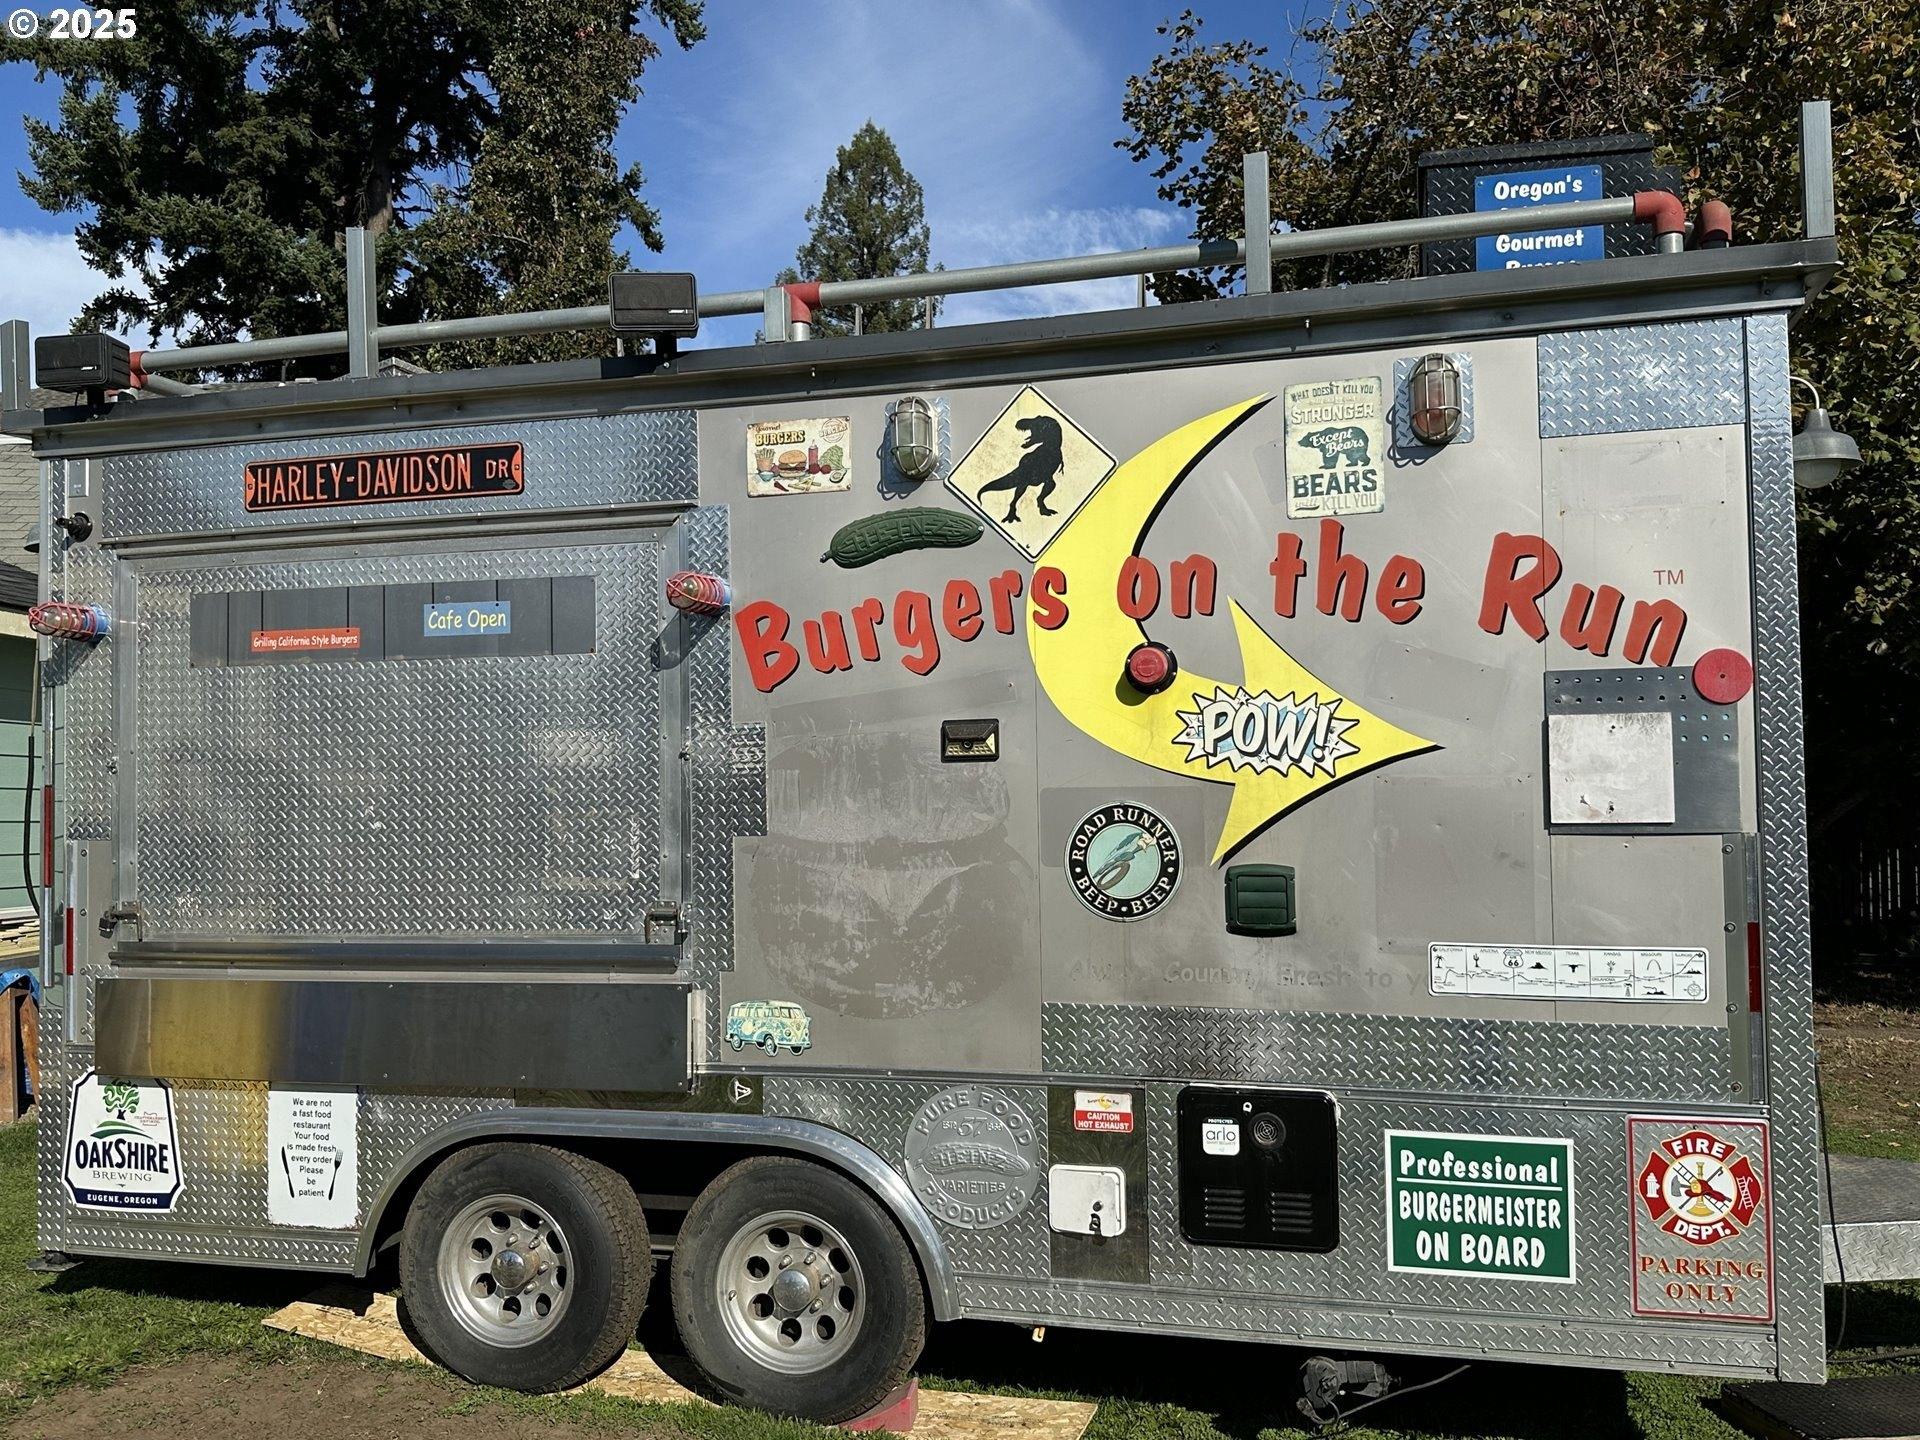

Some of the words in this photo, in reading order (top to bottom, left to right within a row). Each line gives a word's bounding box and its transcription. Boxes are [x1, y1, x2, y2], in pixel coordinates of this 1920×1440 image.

[1494, 175, 1583, 201] Oregon's
[1496, 229, 1584, 253] Gourmet
[1291, 391, 1309, 402] WHAT
[1343, 385, 1359, 394] KILL
[1360, 384, 1374, 394] YOU
[1291, 403, 1374, 425] STRONGER
[755, 430, 805, 446] BURGERS
[1310, 428, 1353, 446] Except
[1326, 439, 1365, 457] Bears
[257, 453, 471, 504] HARLEY-DAVIDSON
[486, 459, 509, 480] DR
[1292, 469, 1377, 498] BEARS
[1322, 495, 1352, 511] KILL
[1354, 492, 1377, 508] YOU
[734, 566, 1069, 693] Burgers
[1117, 554, 1217, 620] on
[1269, 518, 1425, 624] the
[1478, 531, 1687, 667] Run
[1653, 569, 1684, 585] TM
[428, 609, 463, 630] Cafe
[467, 609, 507, 633] Open
[253, 634, 277, 650] Grilling
[278, 635, 310, 648] California
[311, 634, 330, 648] Style
[331, 634, 358, 647] Burgers
[1202, 700, 1333, 763] POW!
[1072, 813, 1107, 861] ROAD
[1113, 807, 1177, 862] RUNNER
[1076, 875, 1118, 913] BEEP
[1130, 876, 1172, 914] BEEP
[292, 1098, 304, 1106] We
[306, 1099, 318, 1107] are
[320, 1099, 332, 1107] not
[299, 1109, 314, 1117] fast
[315, 1110, 332, 1118] food
[915, 1090, 970, 1136] PURE
[978, 1091, 1032, 1146] FOOD
[1087, 1112, 1120, 1121] CAUTION
[293, 1121, 331, 1130] restaurant
[957, 1116, 988, 1138] 57
[1094, 1121, 1130, 1130] EXHAUST
[1206, 1126, 1236, 1141] arlo
[294, 1131, 311, 1140] Your
[313, 1132, 330, 1141] food
[75, 1138, 169, 1174] OAKSHIRE
[295, 1143, 316, 1151] made
[318, 1144, 337, 1153] fresh
[1671, 1138, 1727, 1159] FIRE
[291, 1155, 311, 1164] every
[313, 1155, 332, 1164] order
[938, 1149, 1007, 1170] HEINZ
[1399, 1149, 1558, 1184] Professional
[92, 1170, 152, 1182] BREWING
[299, 1165, 324, 1174] Please
[306, 1177, 316, 1185] be
[941, 1178, 1006, 1194] VARIETIES
[87, 1193, 122, 1204] EUGENE,
[124, 1195, 158, 1205] OREGON
[298, 1188, 325, 1197] patient
[919, 1181, 1026, 1224] PRODUCTS
[1399, 1189, 1562, 1230] BURGERMEISTER
[1673, 1221, 1731, 1240] DEPT.
[1416, 1230, 1449, 1262] ON
[1461, 1233, 1546, 1268] BOARD
[1640, 1255, 1764, 1279] PARKING
[1666, 1282, 1739, 1302] ONLY
